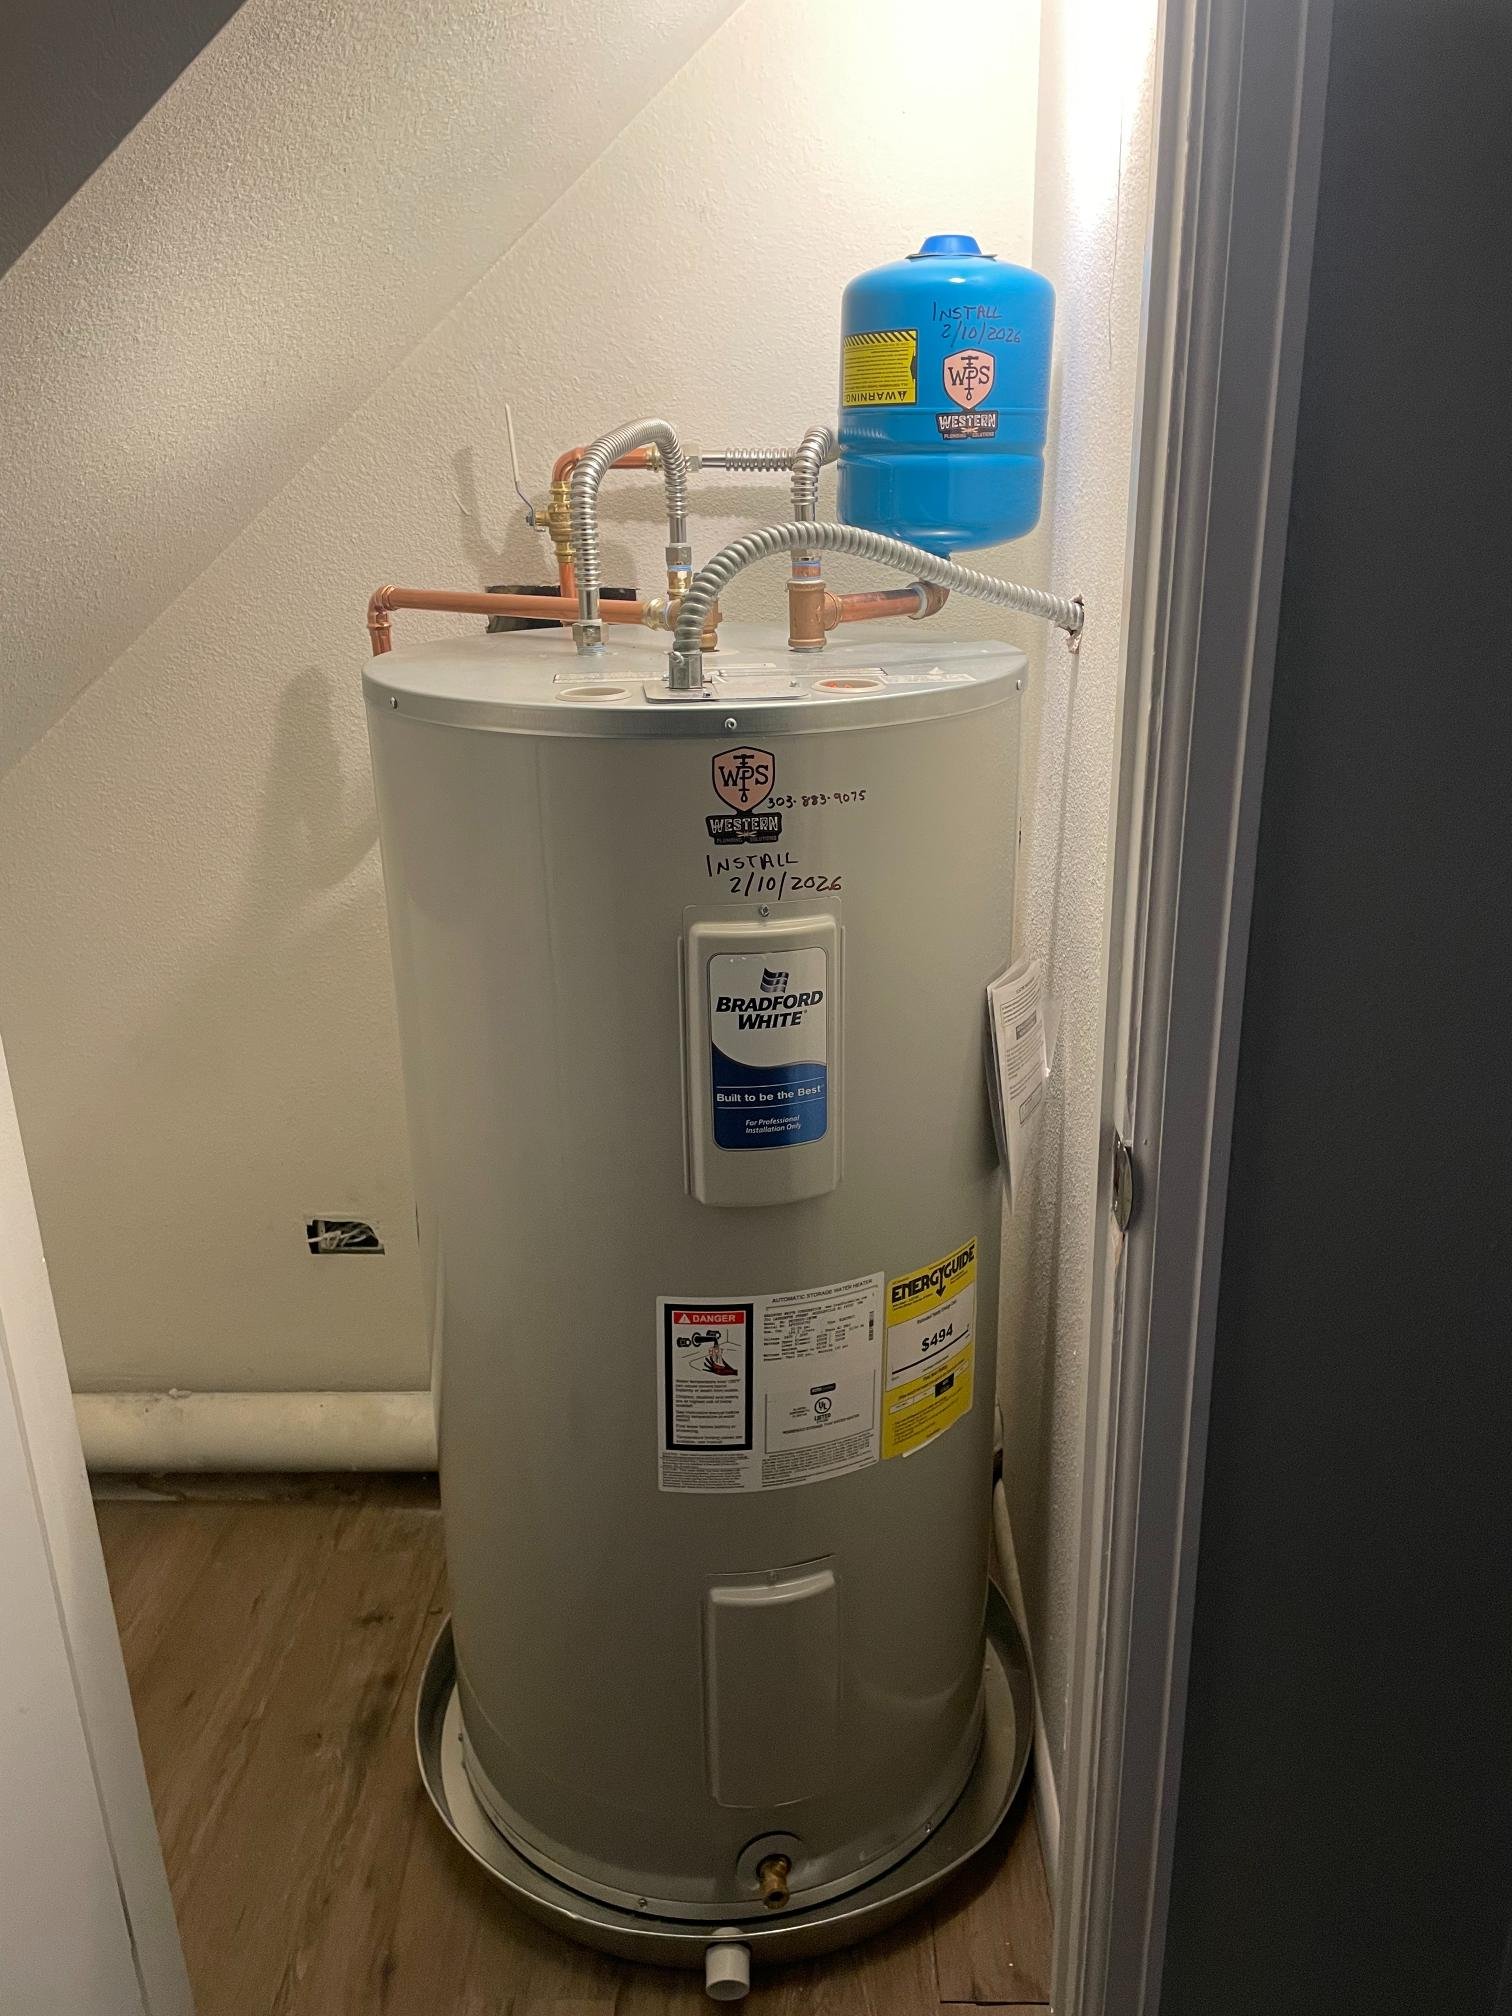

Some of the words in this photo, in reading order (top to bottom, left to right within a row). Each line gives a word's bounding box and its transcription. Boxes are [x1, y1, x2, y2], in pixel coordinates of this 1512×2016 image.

[932, 302, 1003, 322] INSTALL
[941, 322, 1021, 347] 2/10/2026
[846, 391, 896, 402] WARNING
[938, 412, 996, 430] WESTERN
[718, 764, 769, 787] WPS
[709, 816, 779, 834] WESTERN
[706, 852, 799, 877] INSTALL
[729, 871, 843, 900] 2/10/2026
[716, 990, 823, 1013] BRADFORD
[738, 1011, 803, 1030] WHITE
[716, 1093, 742, 1102] Built
[744, 1094, 756, 1102] to
[760, 1093, 774, 1101] be
[777, 1091, 794, 1100] the
[797, 1085, 821, 1097] Best
[745, 1126, 785, 1134] Installation
[786, 1122, 801, 1130] Only
[758, 1115, 800, 1126] Professional
[771, 1294, 805, 1303] AUTOMATIC
[806, 1289, 833, 1299] STORAGE
[834, 1284, 852, 1294] WATER
[852, 1279, 873, 1289] HEATER
[692, 1314, 736, 1323] DANGER
[921, 1323, 953, 1352] $494
